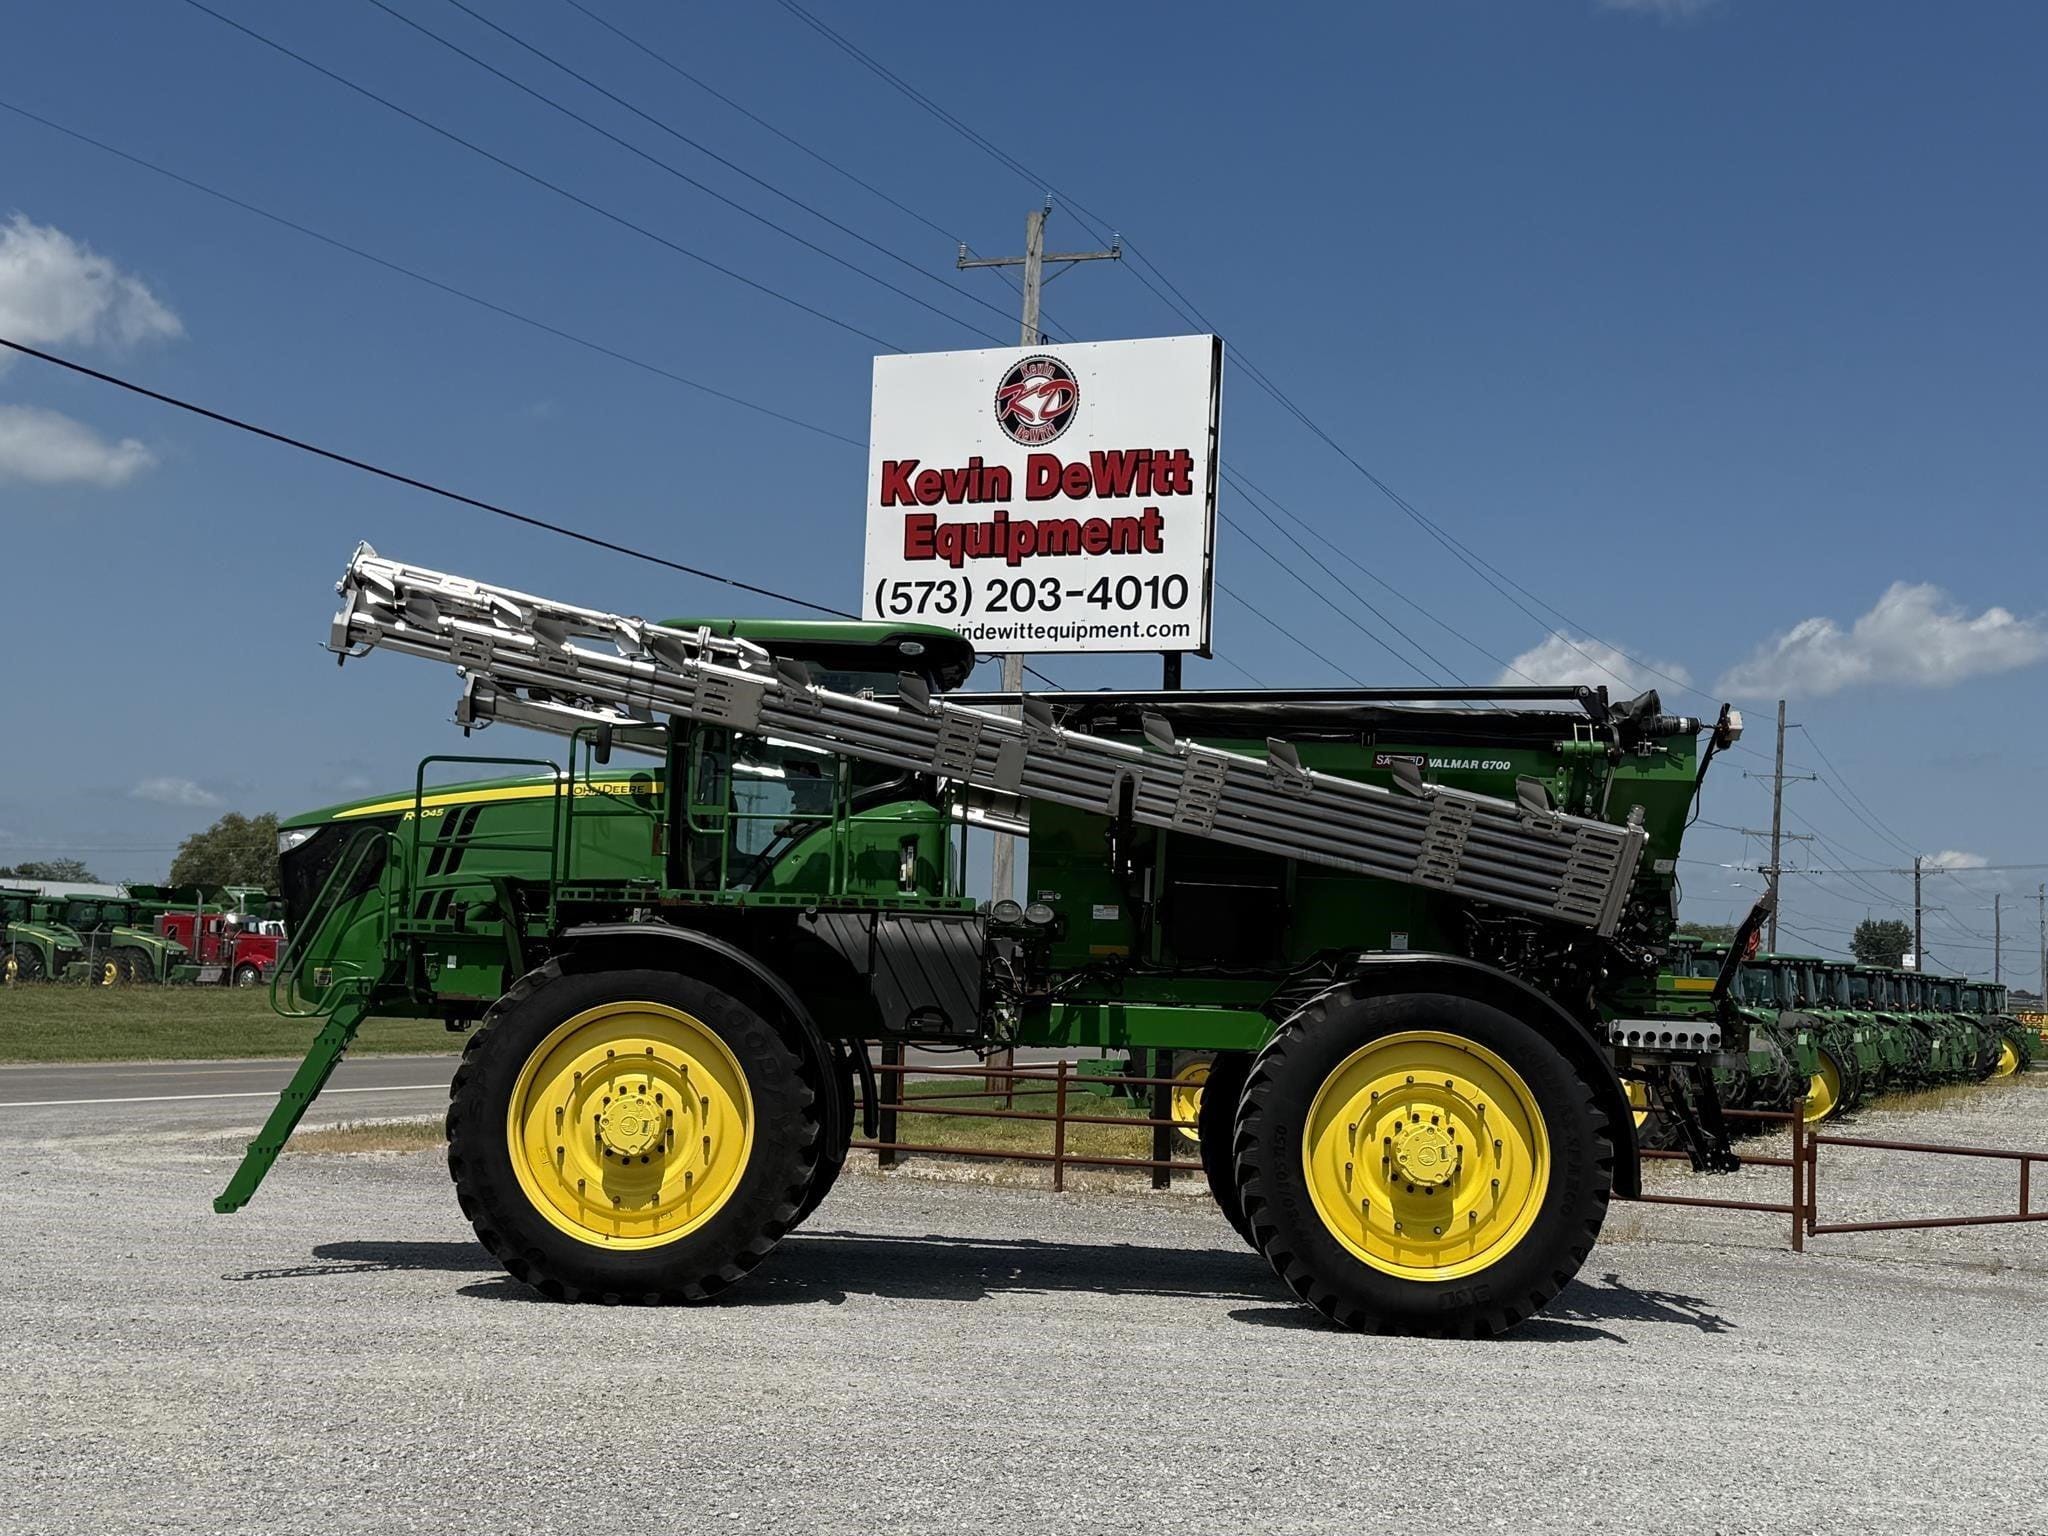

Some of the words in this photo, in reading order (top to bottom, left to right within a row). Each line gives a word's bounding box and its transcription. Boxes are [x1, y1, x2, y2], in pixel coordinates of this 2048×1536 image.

[1021, 361, 1056, 378] Kevin
[998, 379, 1077, 421] KD
[1015, 422, 1058, 442] DeWitt
[881, 456, 1012, 506] Kevin
[1027, 448, 1193, 501] DeWitt
[904, 507, 1164, 568] Equipment
[875, 576, 973, 617] (573)
[985, 574, 1189, 613] 203-4010
[953, 621, 1190, 641] indewittequipment.com
[1429, 758, 1478, 769] VALMAR
[1481, 760, 1511, 770] 6700
[602, 784, 645, 794] DEERE
[403, 808, 444, 821] R045
